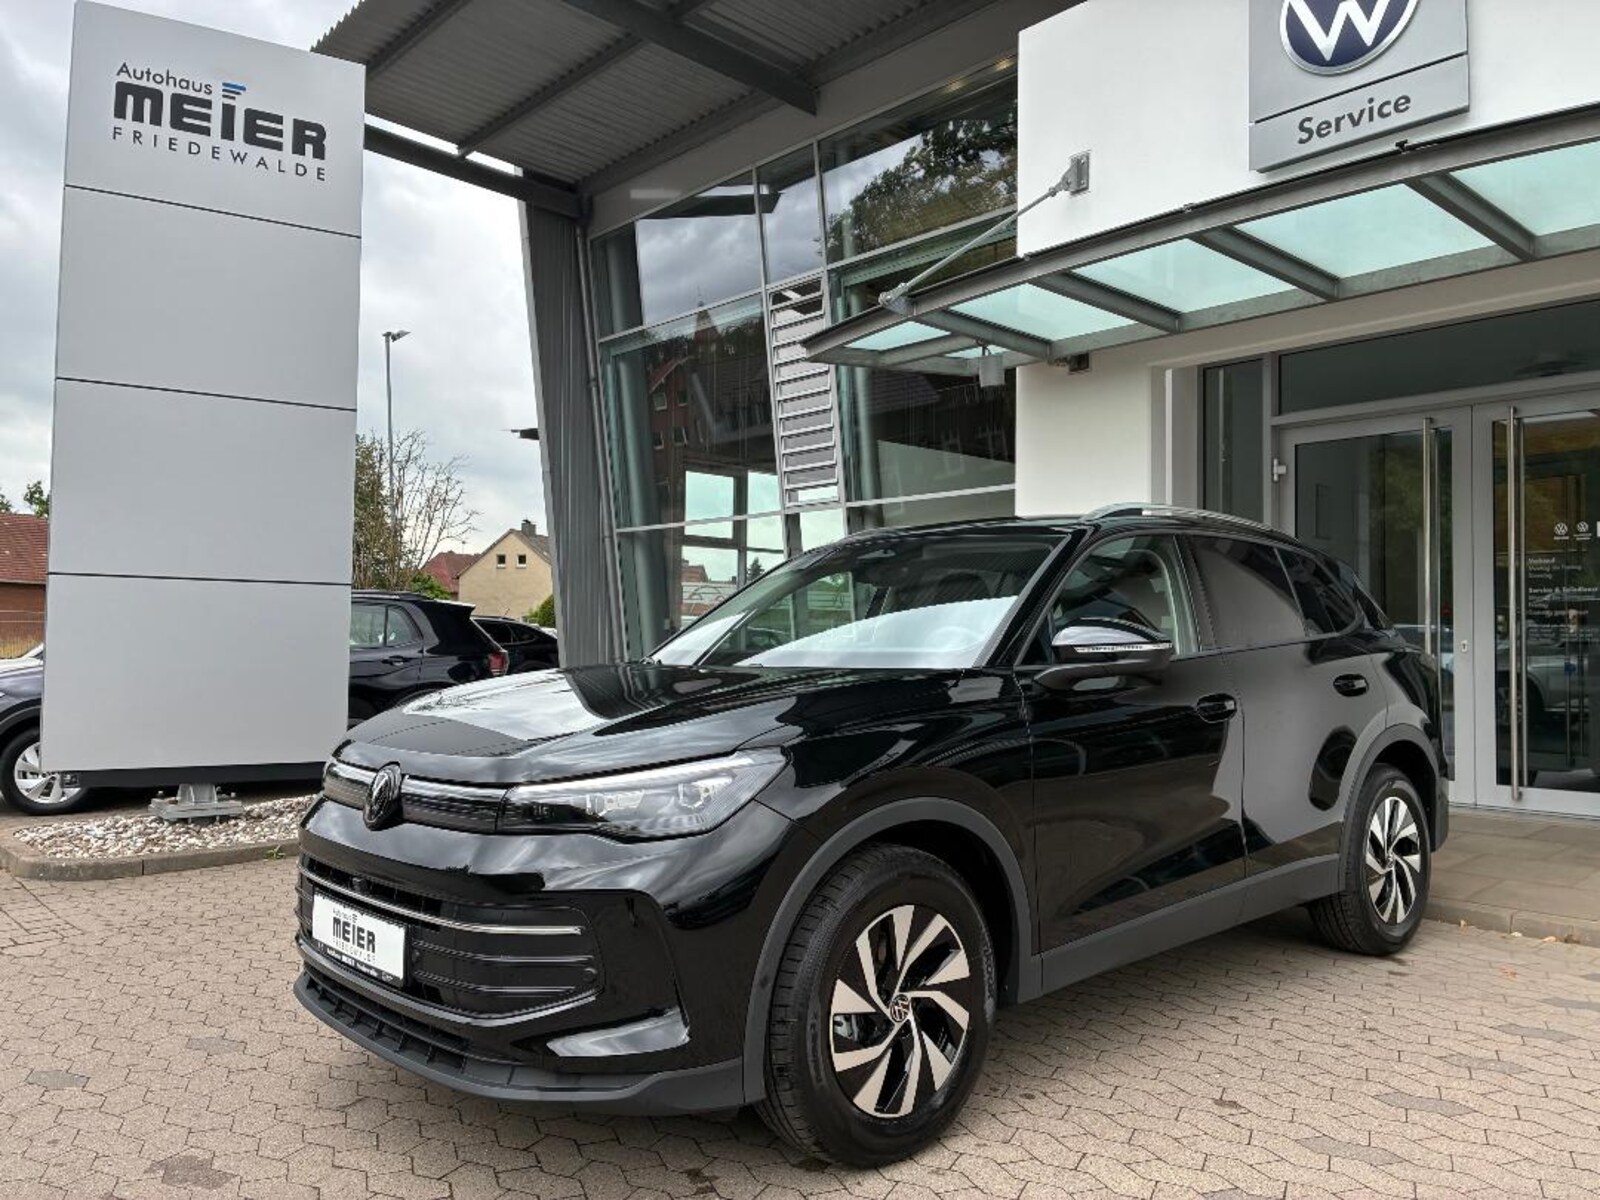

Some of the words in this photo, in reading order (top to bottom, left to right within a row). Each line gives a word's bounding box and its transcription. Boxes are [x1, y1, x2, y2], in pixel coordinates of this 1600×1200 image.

[116, 62, 213, 95] Autohaus
[113, 81, 327, 160] MEIER
[1297, 94, 1411, 144] Service
[112, 126, 326, 181] FRIEDEWALDE
[332, 914, 376, 953] MEIER
